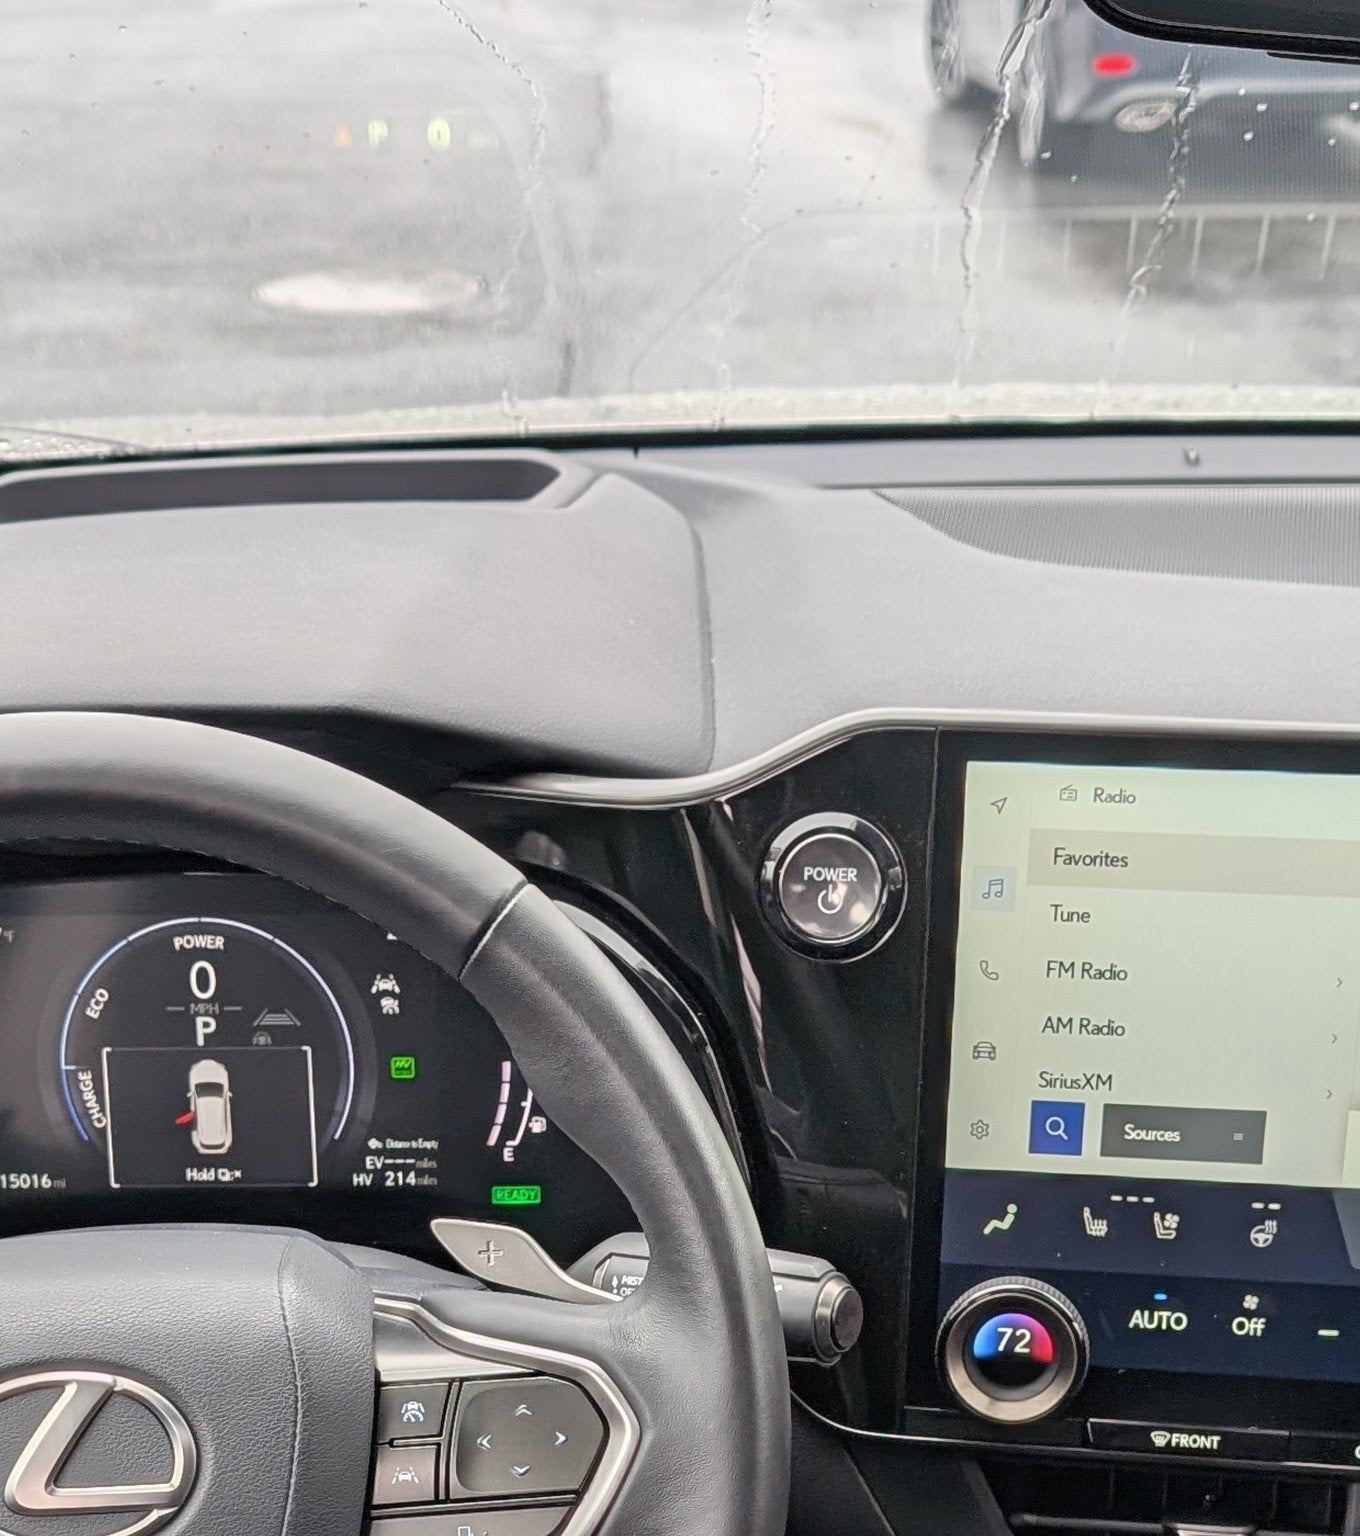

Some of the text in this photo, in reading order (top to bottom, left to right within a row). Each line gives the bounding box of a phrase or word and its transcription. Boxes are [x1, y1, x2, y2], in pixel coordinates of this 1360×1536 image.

[1093, 787, 1137, 805] Radio
[1053, 847, 1129, 869] Favorites
[804, 866, 858, 883] POWER
[1050, 904, 1092, 925] Tune
[173, 934, 225, 951] POWER
[190, 960, 217, 999] 0
[1045, 961, 1129, 983] FM Radio
[84, 988, 110, 1019] ECO
[190, 1002, 220, 1015] MPH
[195, 1016, 217, 1046] P
[1042, 1017, 1127, 1038] AM Radio
[1038, 1071, 1113, 1093] SiriusXM
[78, 1069, 107, 1128] CHARGE
[1123, 1123, 1181, 1143] Sources
[365, 1156, 384, 1169] EV
[502, 1147, 515, 1162] E
[0, 1173, 52, 1189] 15016
[352, 1173, 373, 1187] HV
[384, 1170, 416, 1187] 214
[496, 1189, 537, 1200] READY
[1129, 1308, 1188, 1333] AUTO
[1232, 1316, 1267, 1338] Off
[996, 1327, 1032, 1354] 72
[1172, 1433, 1221, 1451] FRONT
